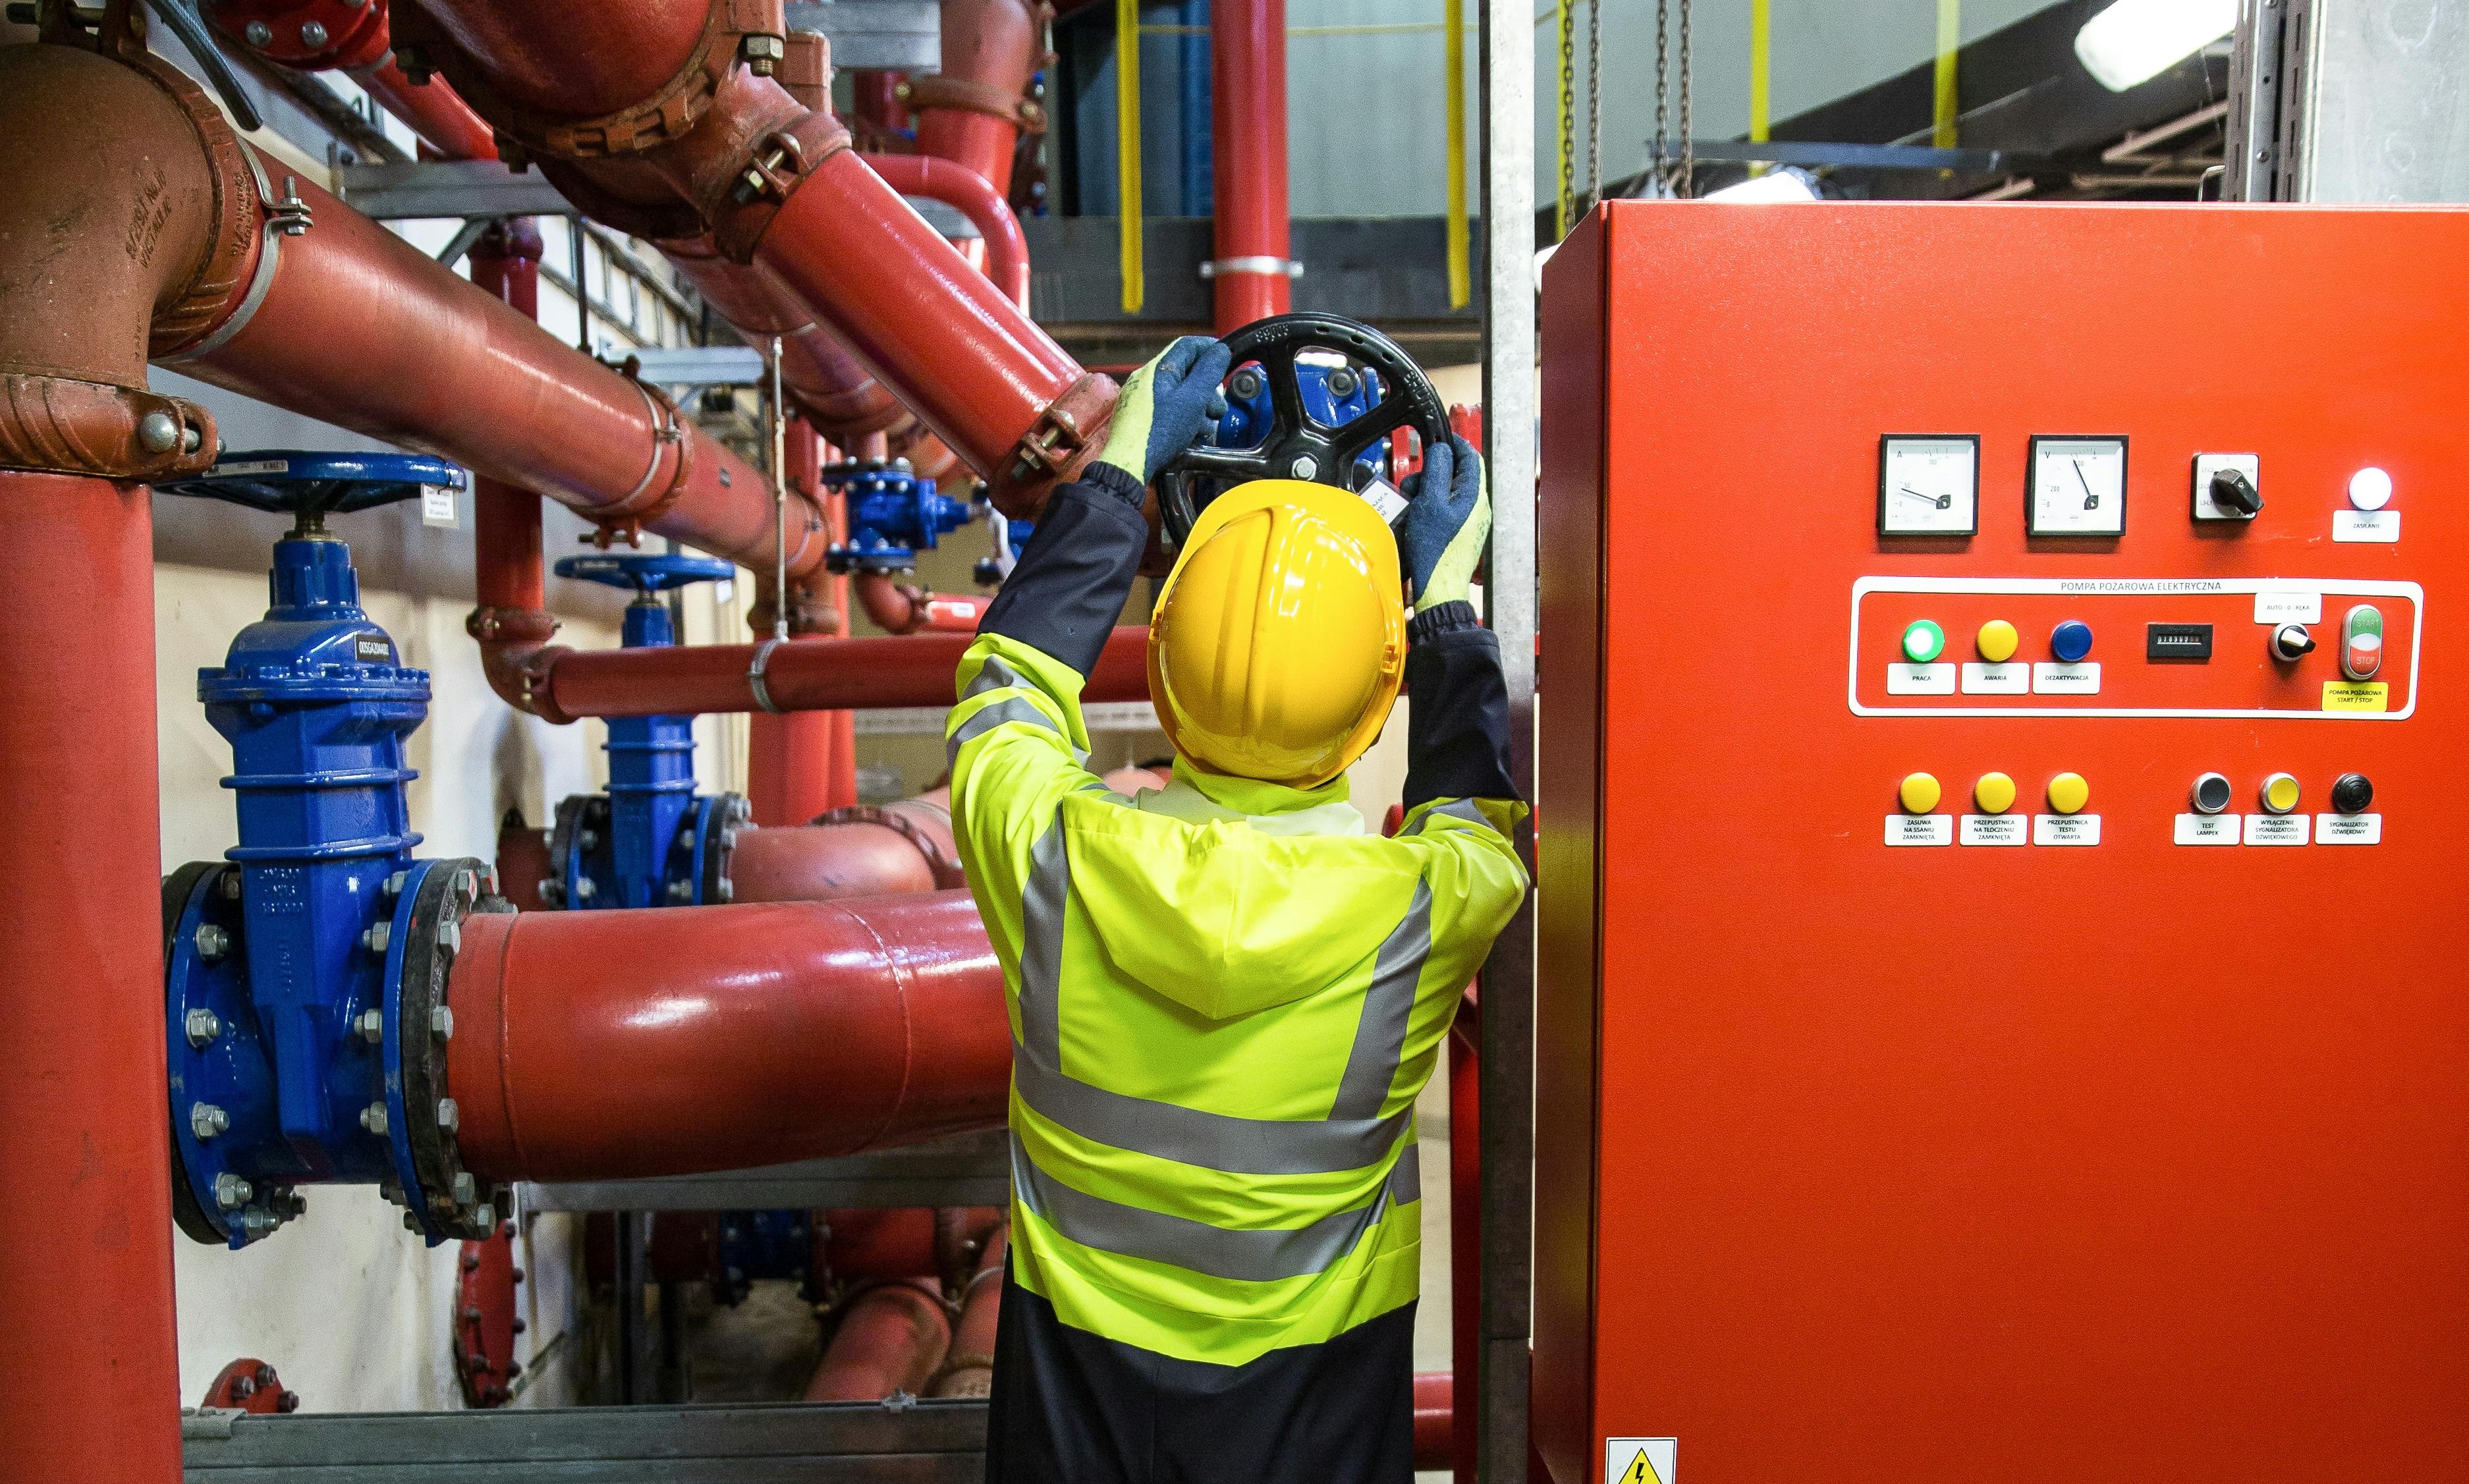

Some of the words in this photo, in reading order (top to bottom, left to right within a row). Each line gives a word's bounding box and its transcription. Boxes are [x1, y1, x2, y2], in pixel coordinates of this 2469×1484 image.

[2061, 582, 2096, 591] POMPA
[2099, 581, 2154, 591] POŻAROWA
[2157, 582, 2221, 591] ELEKTRYCZNA
[2356, 618, 2379, 627] START
[2356, 656, 2376, 665] STOP
